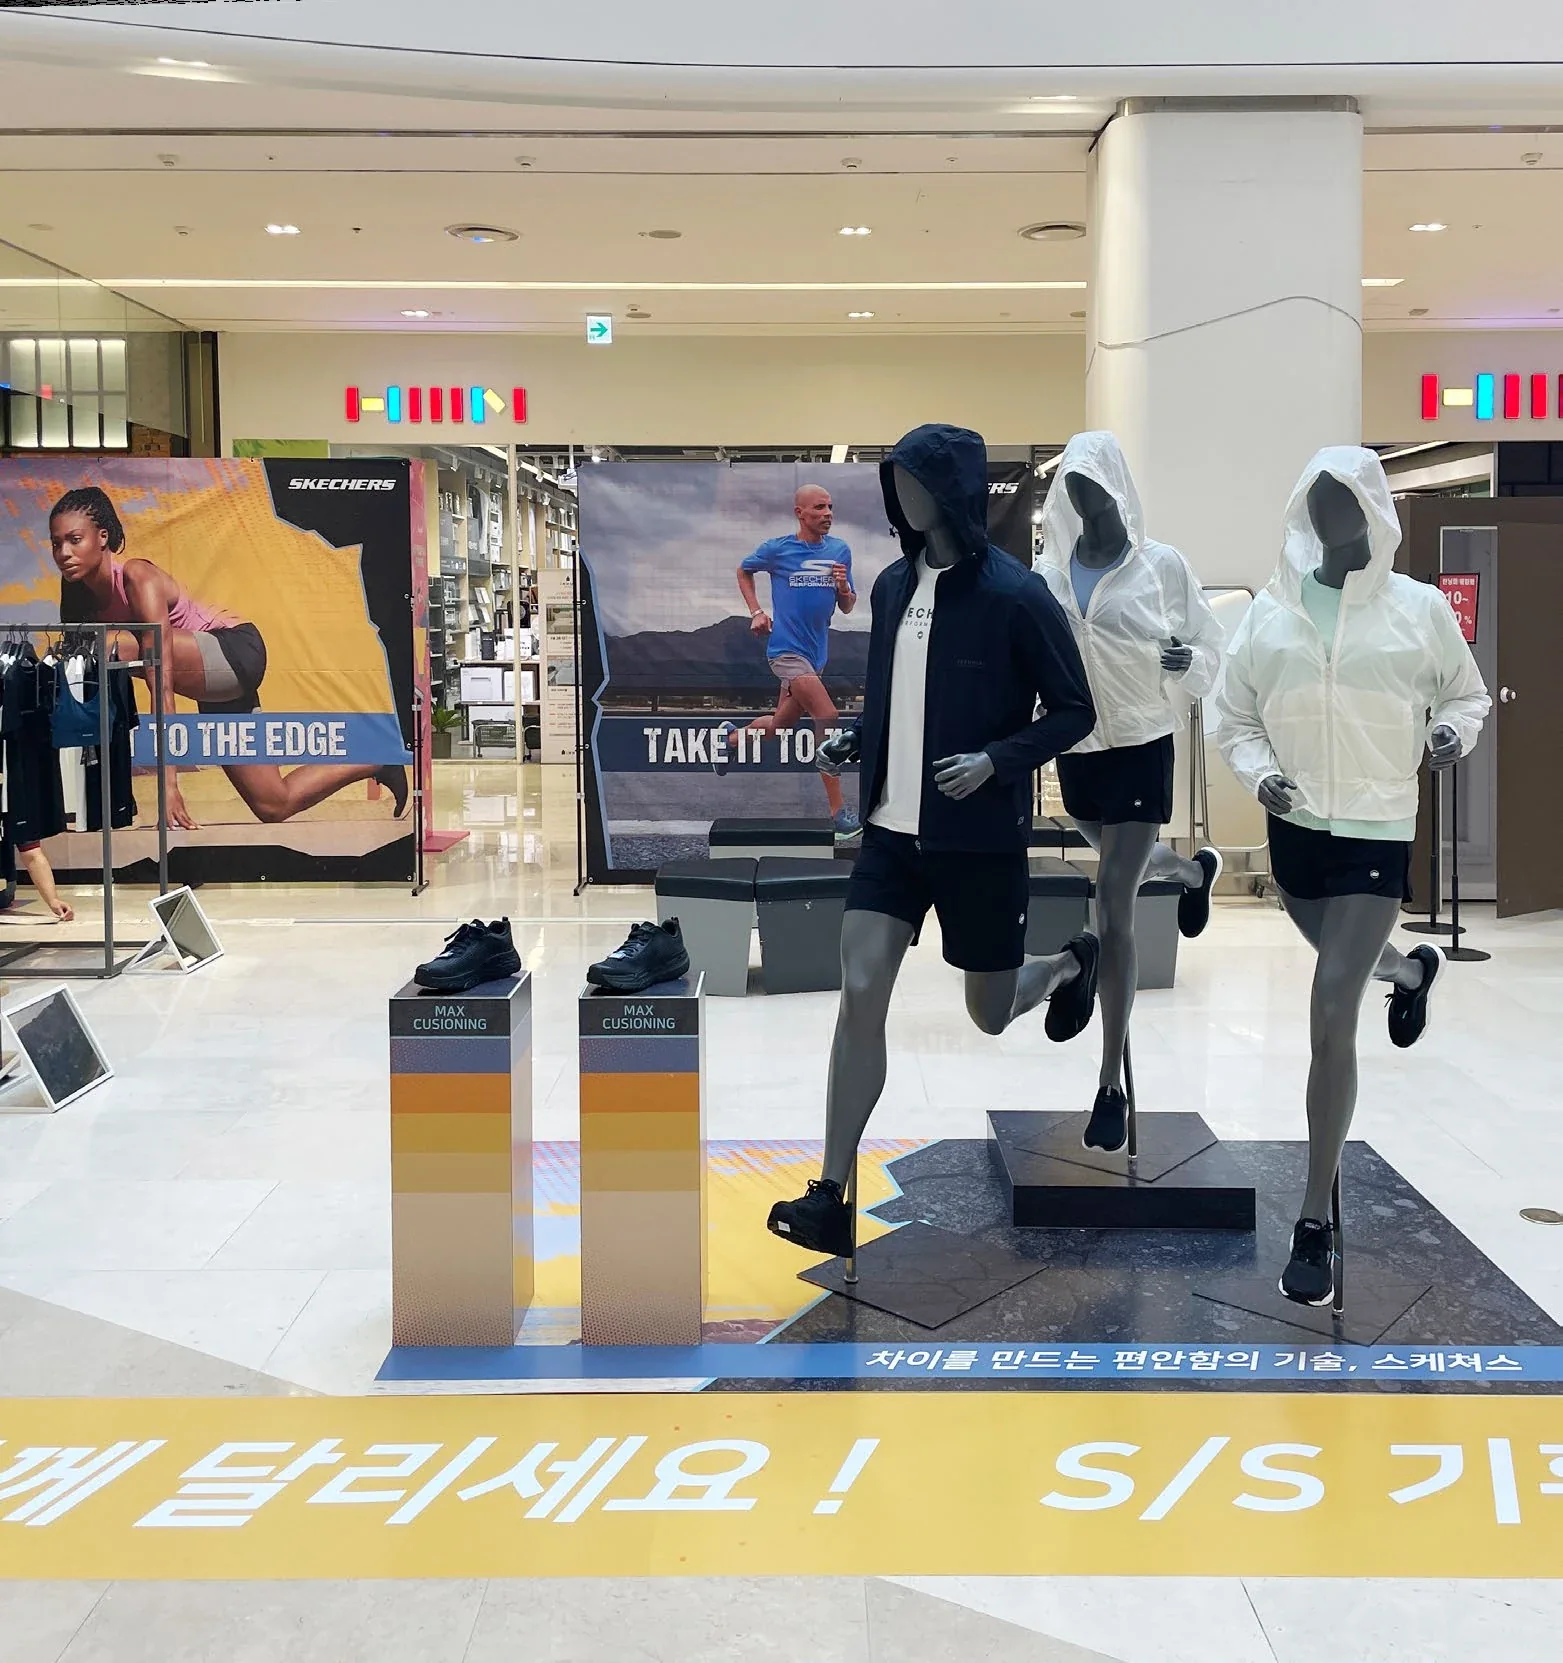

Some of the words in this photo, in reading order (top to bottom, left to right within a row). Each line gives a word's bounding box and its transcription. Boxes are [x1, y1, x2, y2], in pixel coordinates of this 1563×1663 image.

[288, 478, 397, 491] SKECHERS
[789, 575, 835, 583] SKECHER
[149, 722, 188, 757] TO
[197, 721, 257, 757] THE
[265, 721, 347, 756] EDGE
[643, 727, 729, 763] TAKE
[737, 727, 766, 763] IT
[775, 728, 816, 763] TO
[434, 1005, 465, 1016] MAX
[624, 1004, 654, 1016] MAX
[413, 1018, 487, 1030] CUSIONING
[602, 1017, 676, 1030] CUSIONING
[865, 1350, 978, 1370] 차이를
[991, 1350, 1101, 1370] 만드는
[1112, 1350, 1259, 1371] 편안함의
[1273, 1351, 1358, 1372] 기술,
[0, 1440, 168, 1527] 께
[1040, 1436, 1325, 1521] S/S
